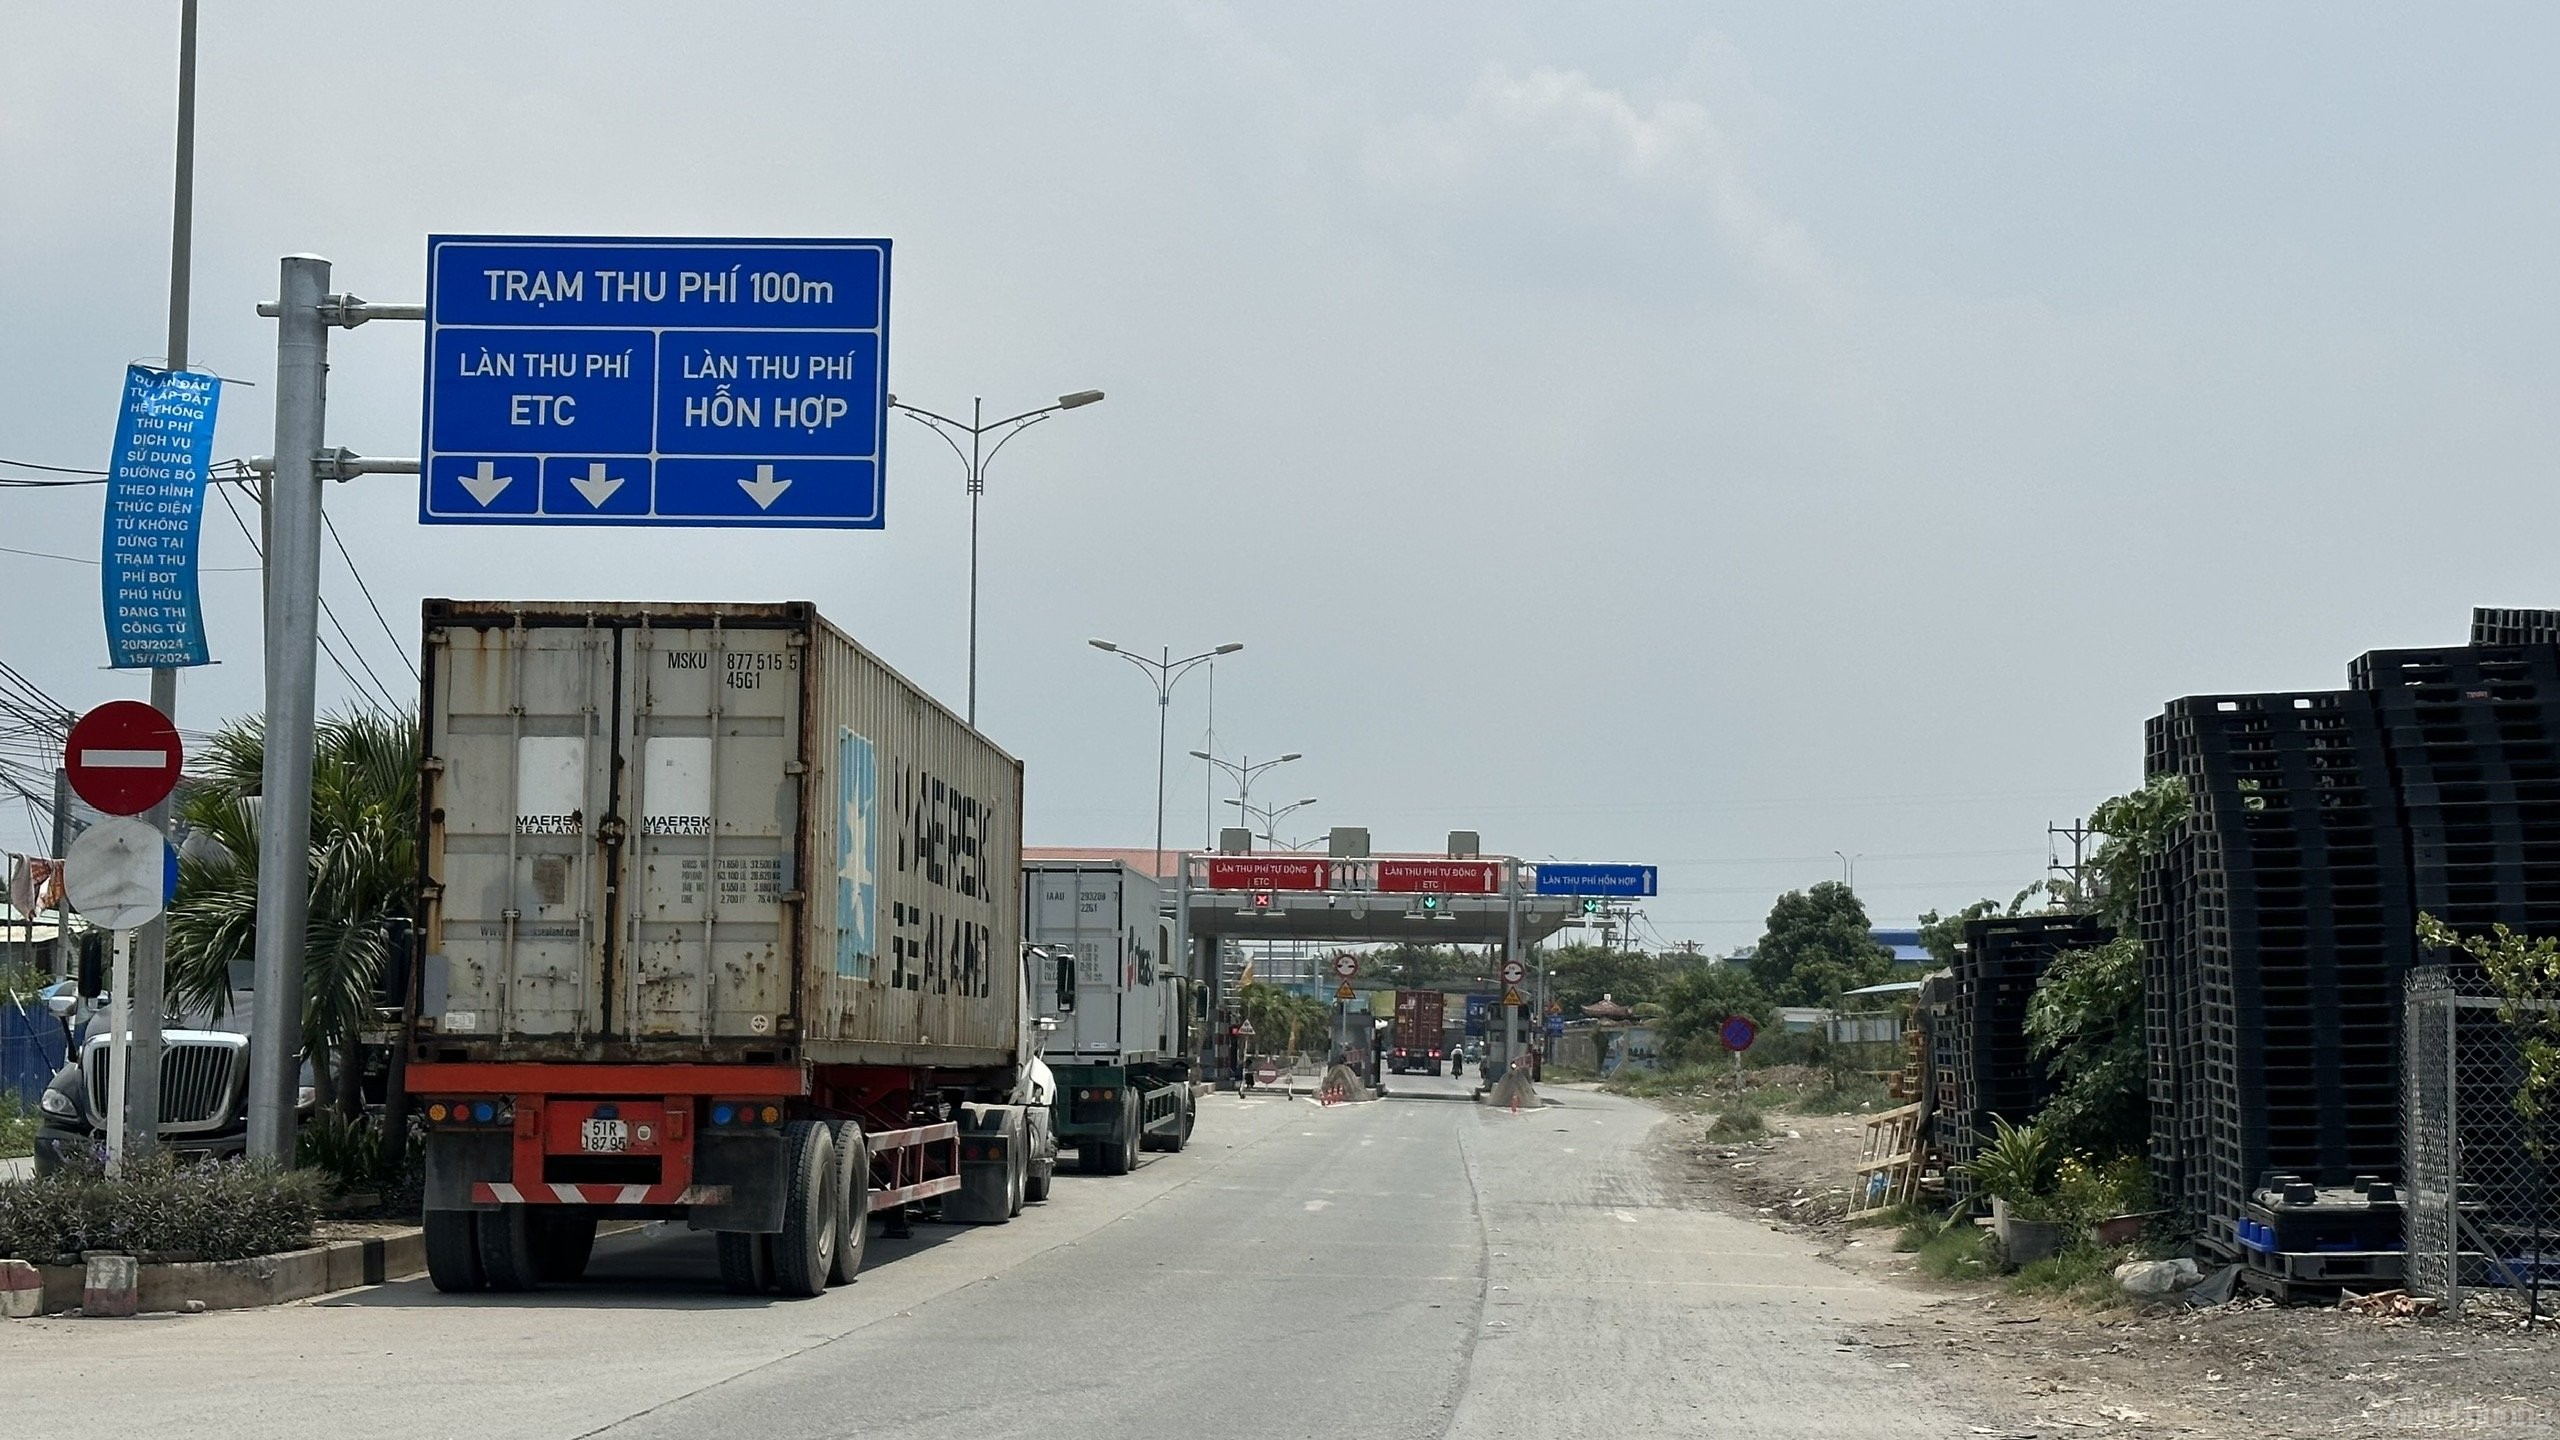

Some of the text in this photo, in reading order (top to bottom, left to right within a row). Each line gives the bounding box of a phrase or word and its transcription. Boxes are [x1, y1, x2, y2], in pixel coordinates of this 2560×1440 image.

[484, 264, 834, 308] TRẠM THU PHÍ 100m
[460, 347, 633, 378] LÀN THU PHÍ
[683, 350, 856, 380] LÀN THU PHÍ
[154, 402, 204, 420] THỐNG
[510, 394, 576, 426] ETC
[685, 383, 848, 434] HỖN HỢP
[137, 418, 194, 433] THU PHÍ
[133, 434, 191, 449] DỊCH VỤ
[127, 448, 192, 465] SỬ DỤNG
[120, 466, 196, 482] ĐƯỜNG BỘ
[119, 484, 194, 497] THEO HÌNH
[116, 498, 192, 514] THỨC ĐIỆN
[138, 518, 189, 531] KHÔNG
[161, 537, 184, 550] TẠI
[115, 553, 186, 567] TRẠM THU
[122, 570, 177, 583] PHÍ BOT
[119, 586, 182, 600] PHÚ HỮU
[119, 607, 186, 618] ĐANG THI
[121, 621, 164, 633] CÔNG
[121, 638, 183, 650] 20/3/2024
[668, 652, 707, 669] MSKU
[789, 654, 797, 670] 5
[726, 671, 760, 689] 45G1
[643, 816, 711, 827] MAERSK
[1216, 863, 1234, 873] LÀN
[1235, 864, 1253, 873] THU
[1254, 864, 1269, 873] PHÍ
[1385, 865, 1403, 876] LÀN
[1404, 867, 1422, 876] THU
[1423, 867, 1439, 877] PHÍ
[1253, 878, 1270, 886] ETC
[1422, 880, 1439, 889] ETC
[1542, 874, 1560, 884] LÀN
[1562, 876, 1580, 885] THU
[1582, 875, 1597, 885] PHÍ
[1046, 892, 1065, 901] IAAU
[593, 1121, 617, 1136] 51R
